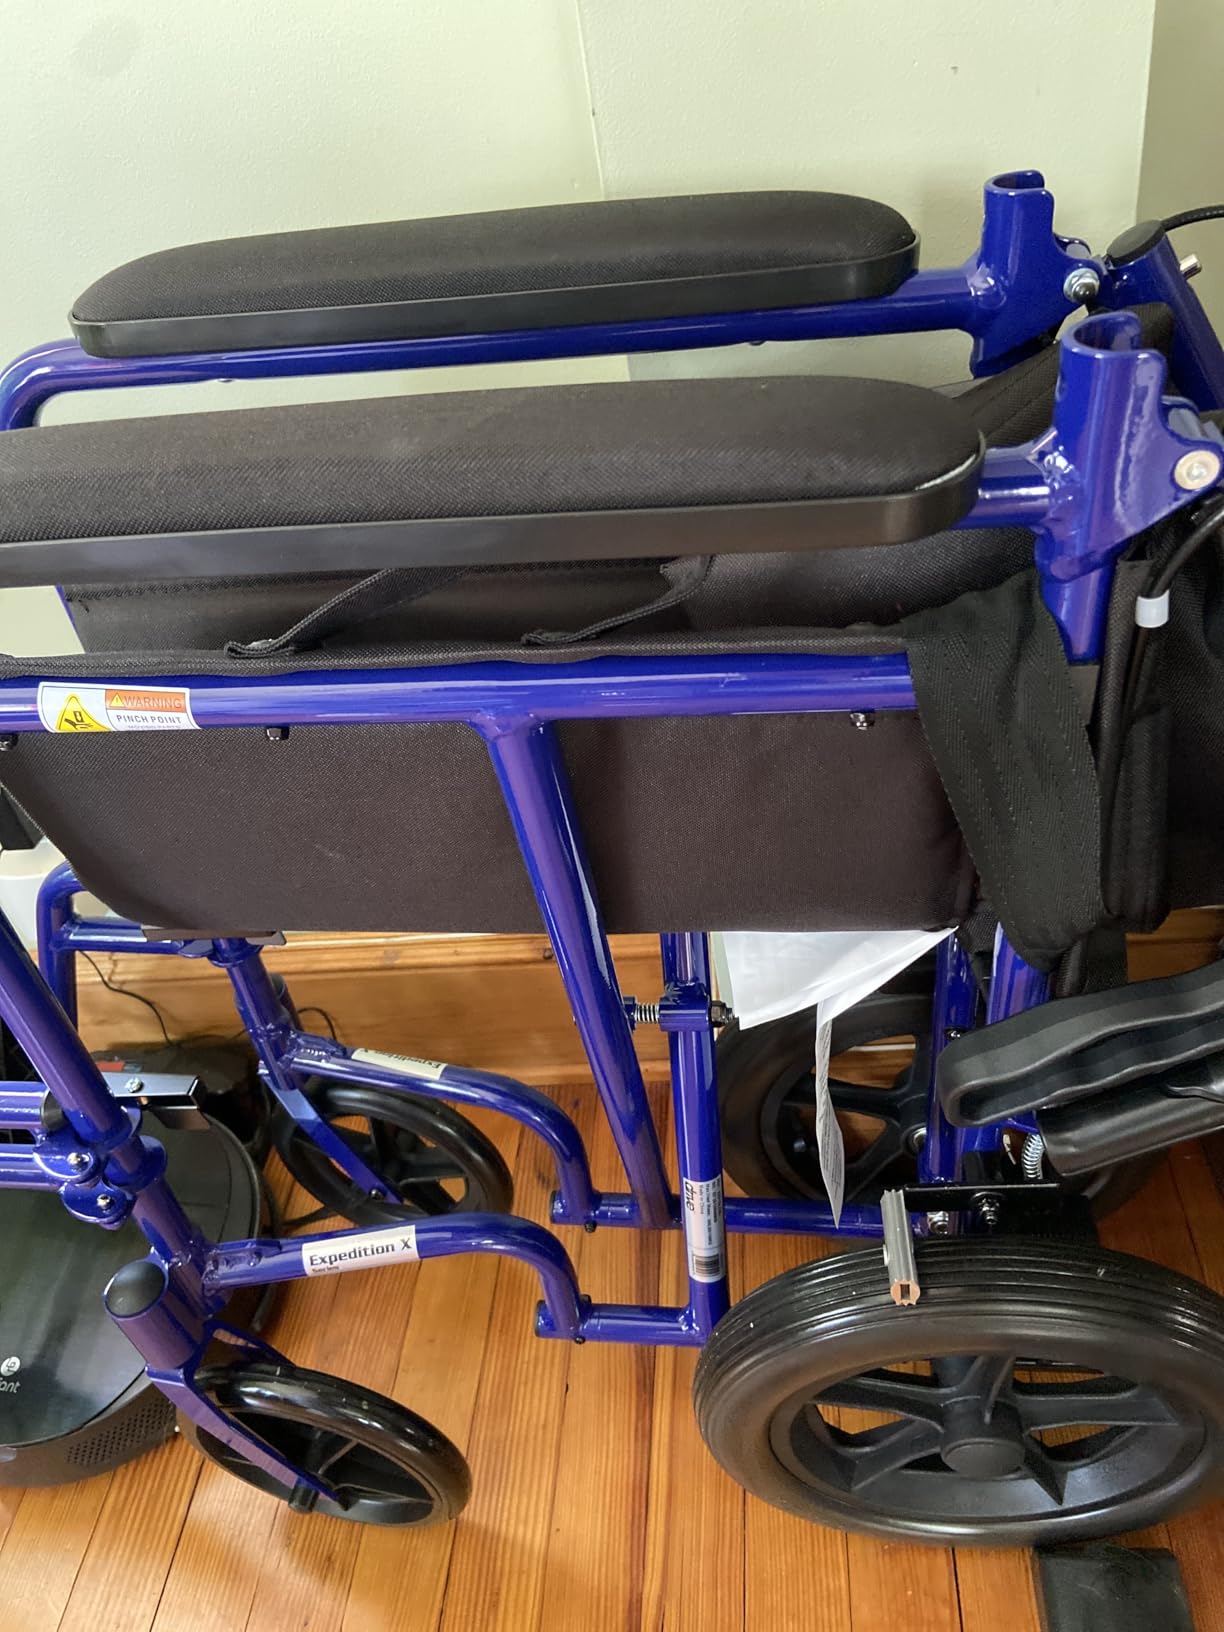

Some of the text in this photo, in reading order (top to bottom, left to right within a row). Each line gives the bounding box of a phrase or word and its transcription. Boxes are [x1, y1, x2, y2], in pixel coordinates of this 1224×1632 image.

[124, 696, 182, 709] WARNING
[116, 714, 182, 724] PINCH POINT
[309, 1237, 412, 1266] Expedition X
[0, 1377, 21, 1394] ant
